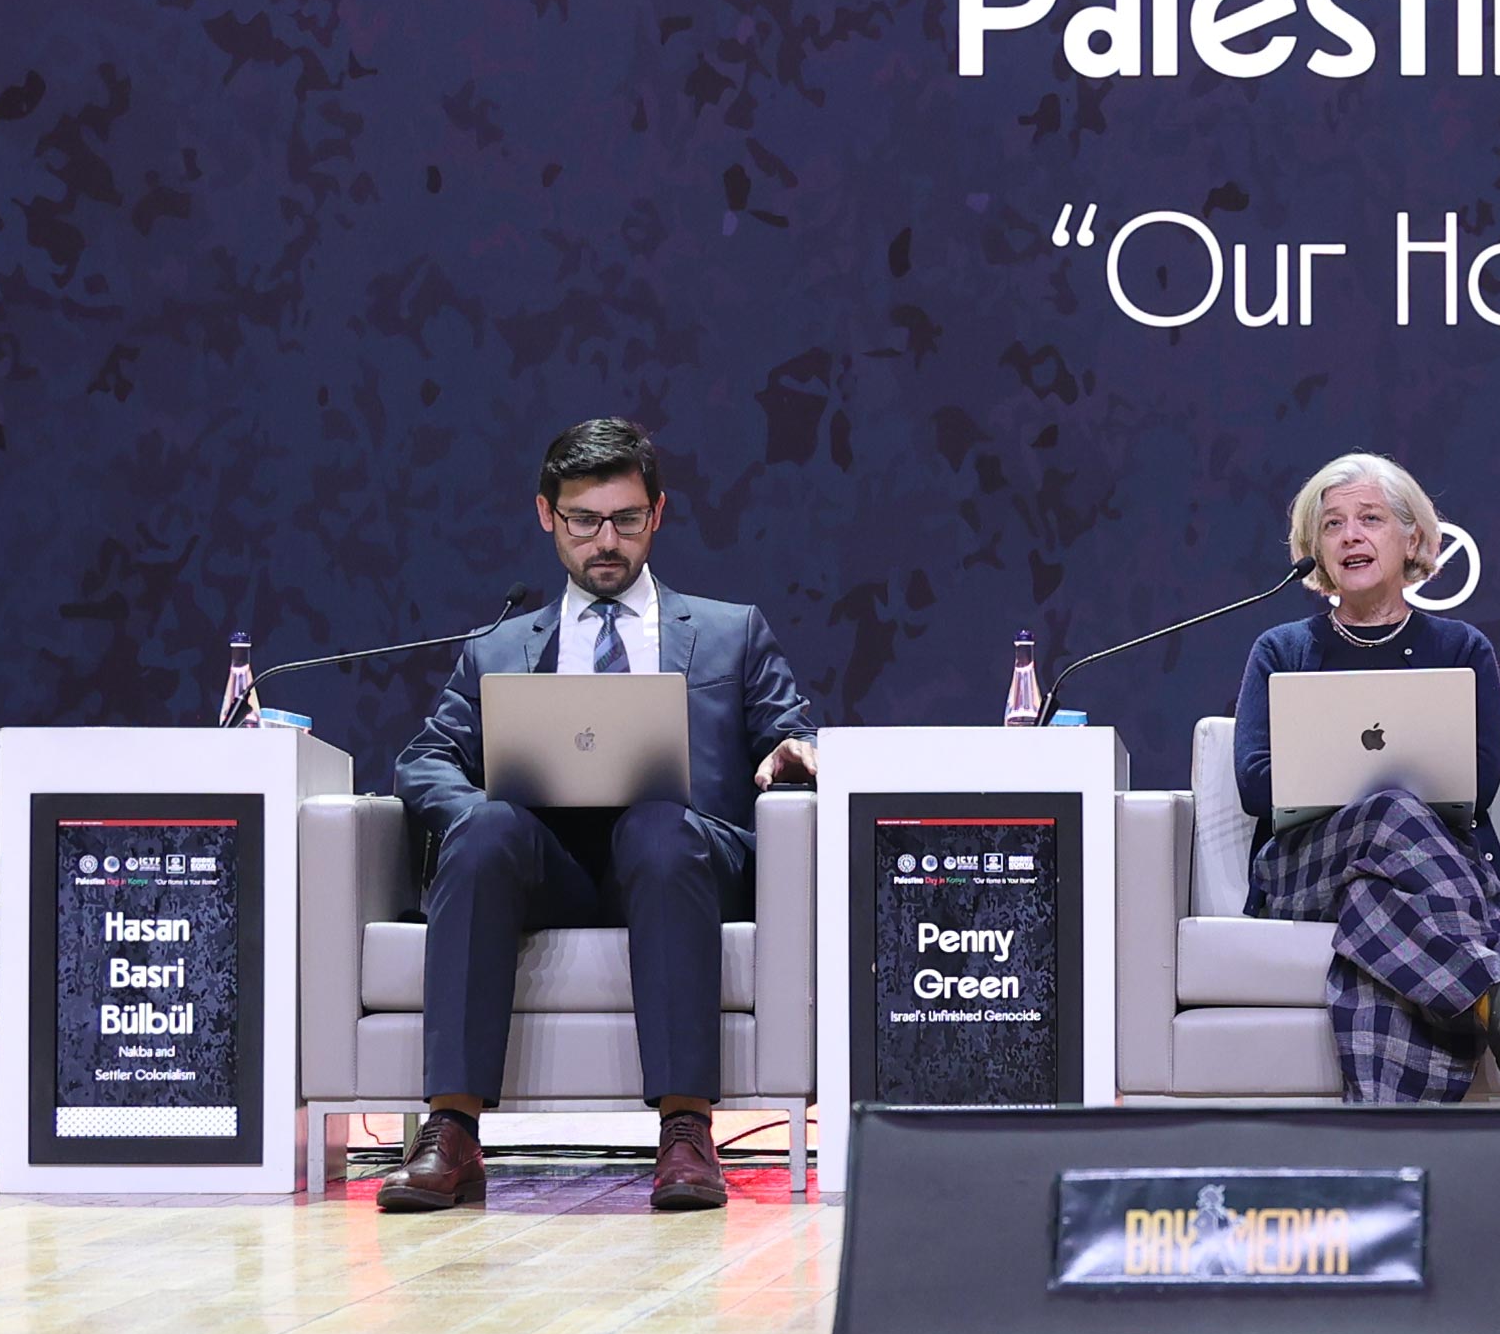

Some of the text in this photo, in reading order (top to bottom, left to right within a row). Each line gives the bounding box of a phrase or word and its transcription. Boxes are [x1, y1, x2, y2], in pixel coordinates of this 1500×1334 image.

[139, 857, 161, 865] ICYF
[957, 856, 978, 864] ICYF
[105, 912, 190, 942] Hasan
[917, 922, 1015, 961] Penny
[109, 958, 185, 988] Basri
[913, 969, 1019, 999] Green
[100, 1004, 193, 1035] Bülbül
[928, 1010, 982, 1022] Unfinished
[984, 1010, 1041, 1022] Genocide
[119, 1046, 176, 1057] Nakba and
[95, 1069, 196, 1081] Settler Colonialism
[1125, 1208, 1349, 1275] BAY MEDYA
